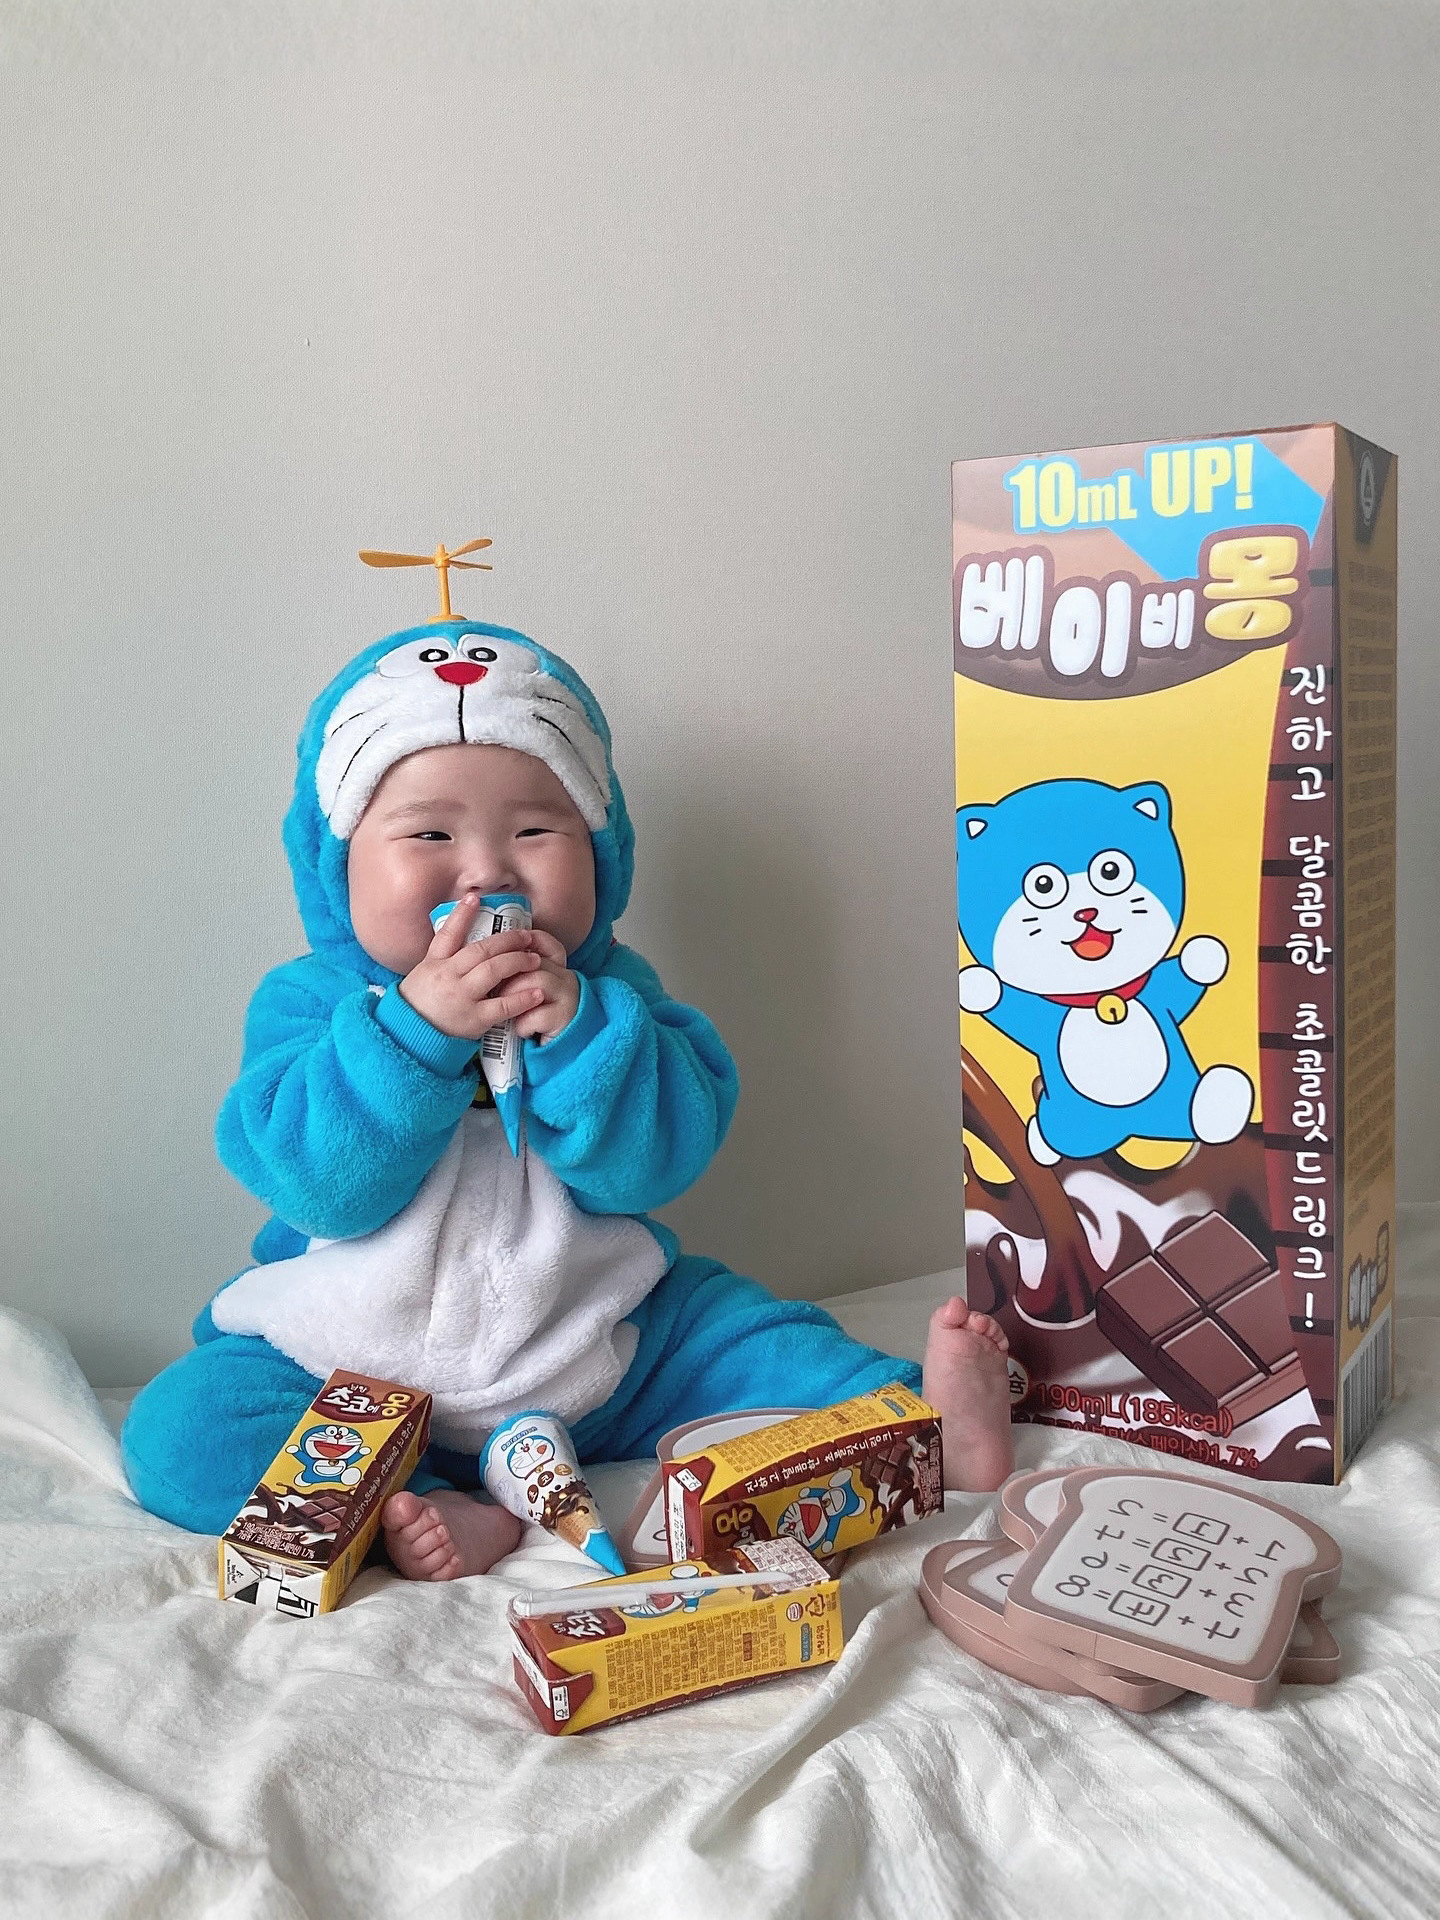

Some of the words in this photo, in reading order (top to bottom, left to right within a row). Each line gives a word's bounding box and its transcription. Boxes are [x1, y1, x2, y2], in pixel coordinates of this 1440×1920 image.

[1009, 460, 1138, 528] 10mL
[1150, 443, 1255, 518] UP!
[959, 535, 1301, 679] 베이비몽
[1285, 663, 1332, 801] 진하고
[1285, 834, 1332, 975] 달콤한
